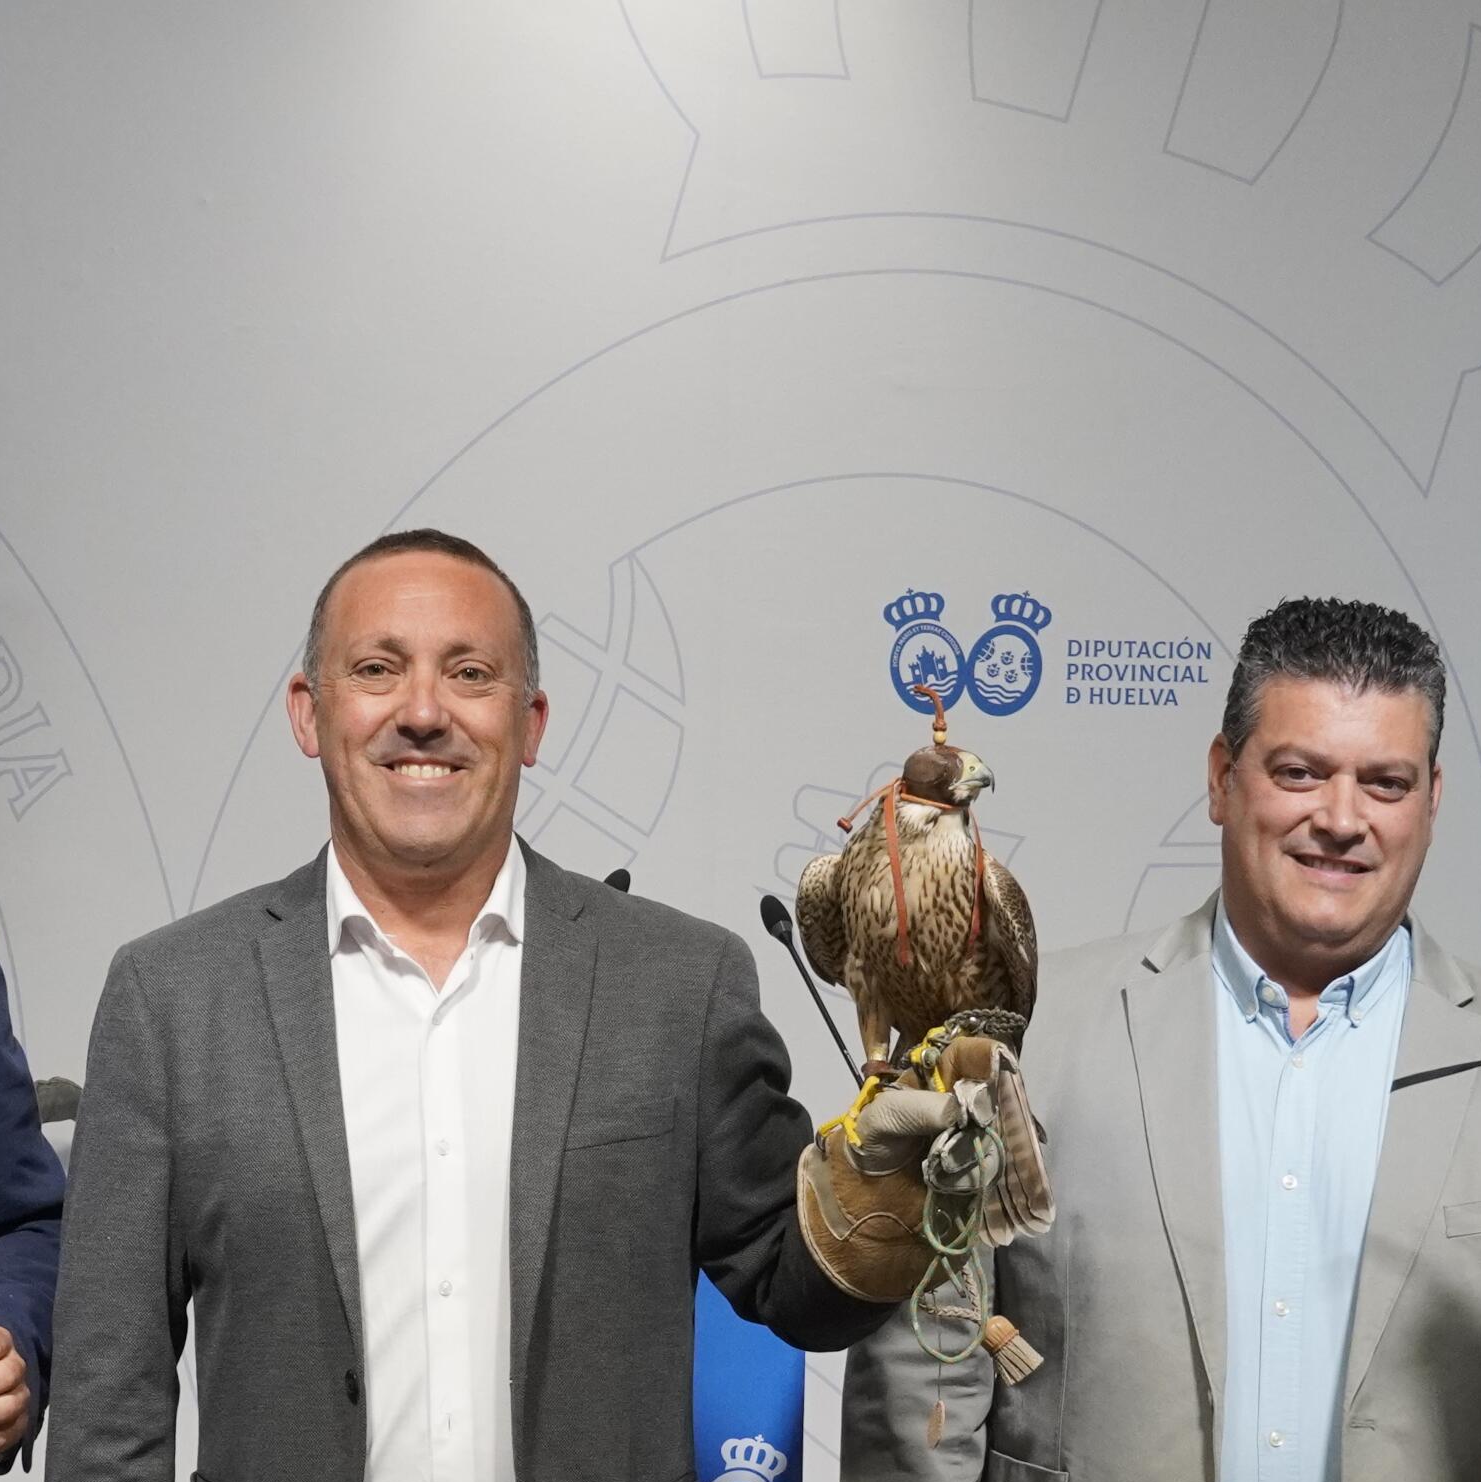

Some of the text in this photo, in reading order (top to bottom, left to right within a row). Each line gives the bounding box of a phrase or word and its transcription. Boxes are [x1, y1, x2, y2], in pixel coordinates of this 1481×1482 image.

[1066, 636, 1212, 660] DIPUTACIÓN
[1065, 662, 1209, 684] PROVINCIAL
[1089, 686, 1179, 707] HUELVA
